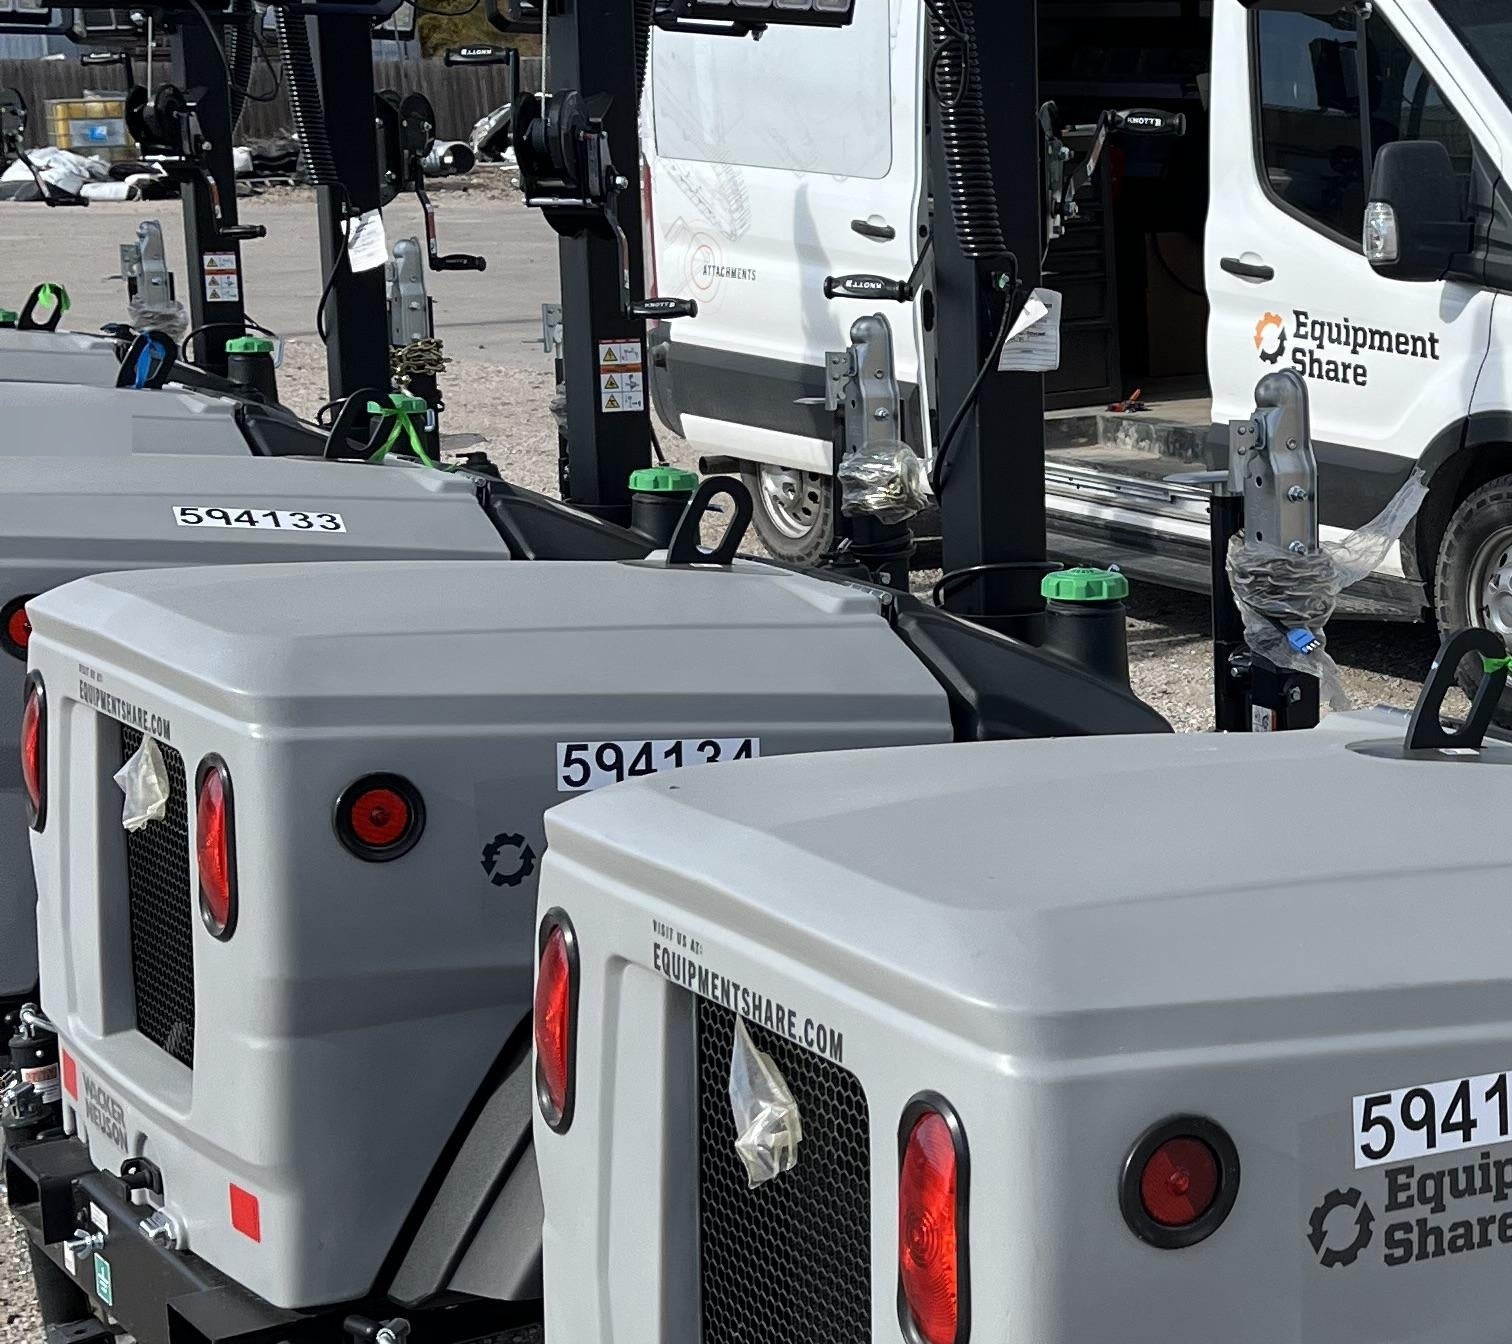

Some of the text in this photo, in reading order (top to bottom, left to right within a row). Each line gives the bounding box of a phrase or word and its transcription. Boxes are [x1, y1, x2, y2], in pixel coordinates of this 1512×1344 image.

[702, 264, 757, 281] ATTACHMENTS
[1292, 309, 1440, 360] Equipment
[1291, 347, 1368, 386] Share
[179, 507, 342, 531] 594133
[79, 679, 171, 741] EQUIPMENTSHARE.COM
[652, 920, 674, 942] VISIT
[676, 932, 687, 948] US
[652, 942, 844, 1063] EQUIPMENTSHARE.COM
[82, 1071, 126, 1130] WACKER
[86, 1096, 129, 1155] NEUSON
